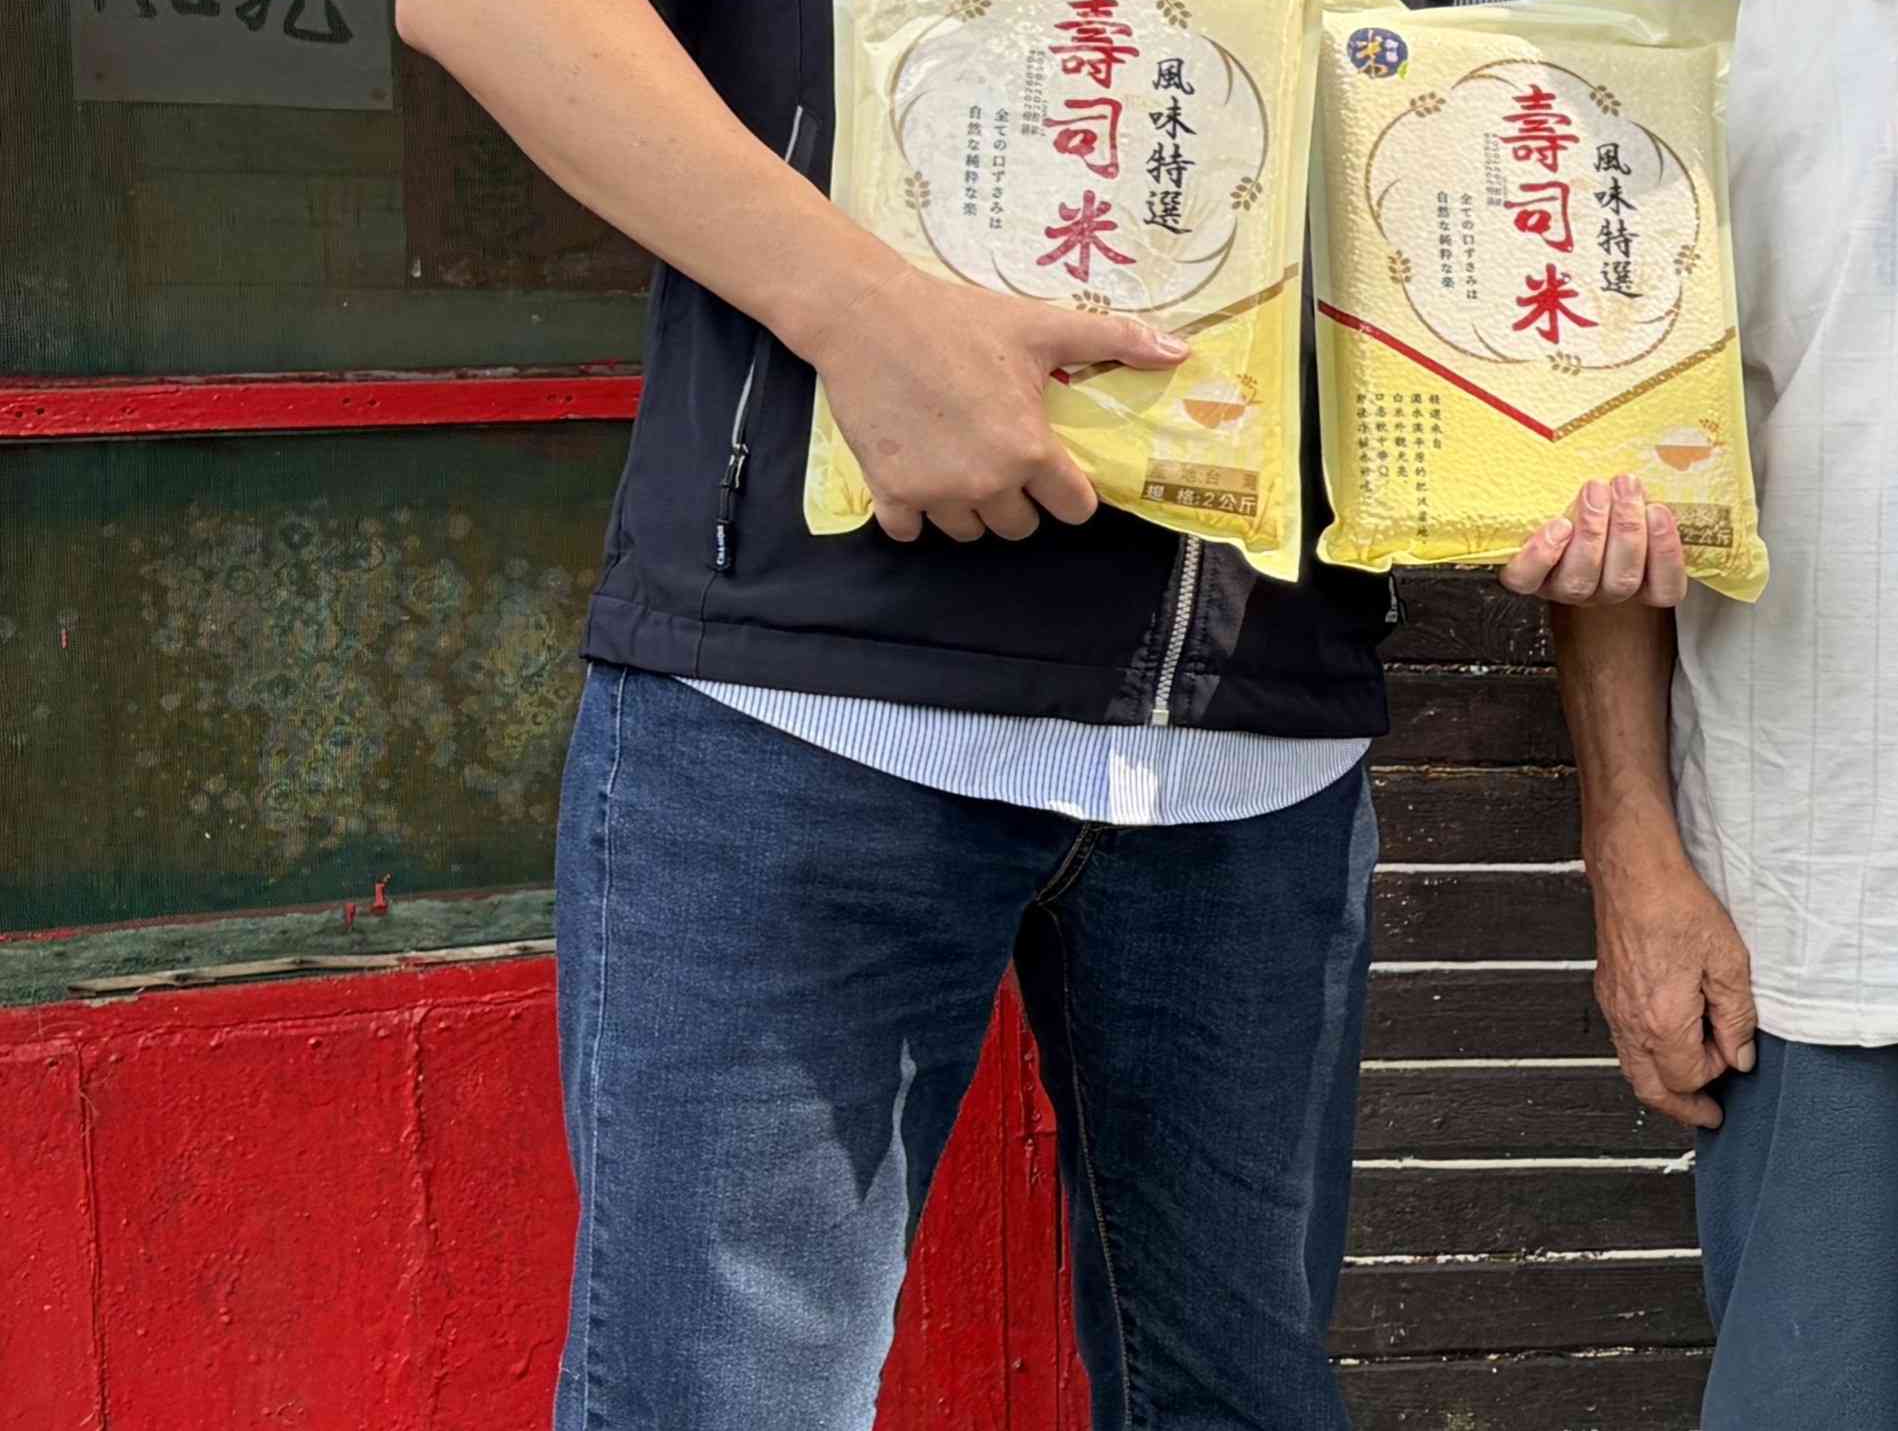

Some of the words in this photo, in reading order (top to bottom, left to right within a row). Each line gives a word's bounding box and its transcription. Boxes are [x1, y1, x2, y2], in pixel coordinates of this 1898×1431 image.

[1142, 57, 1199, 235] 風味特選
[1499, 83, 1599, 345] 壽司米
[1592, 142, 1645, 301] 風味特選
